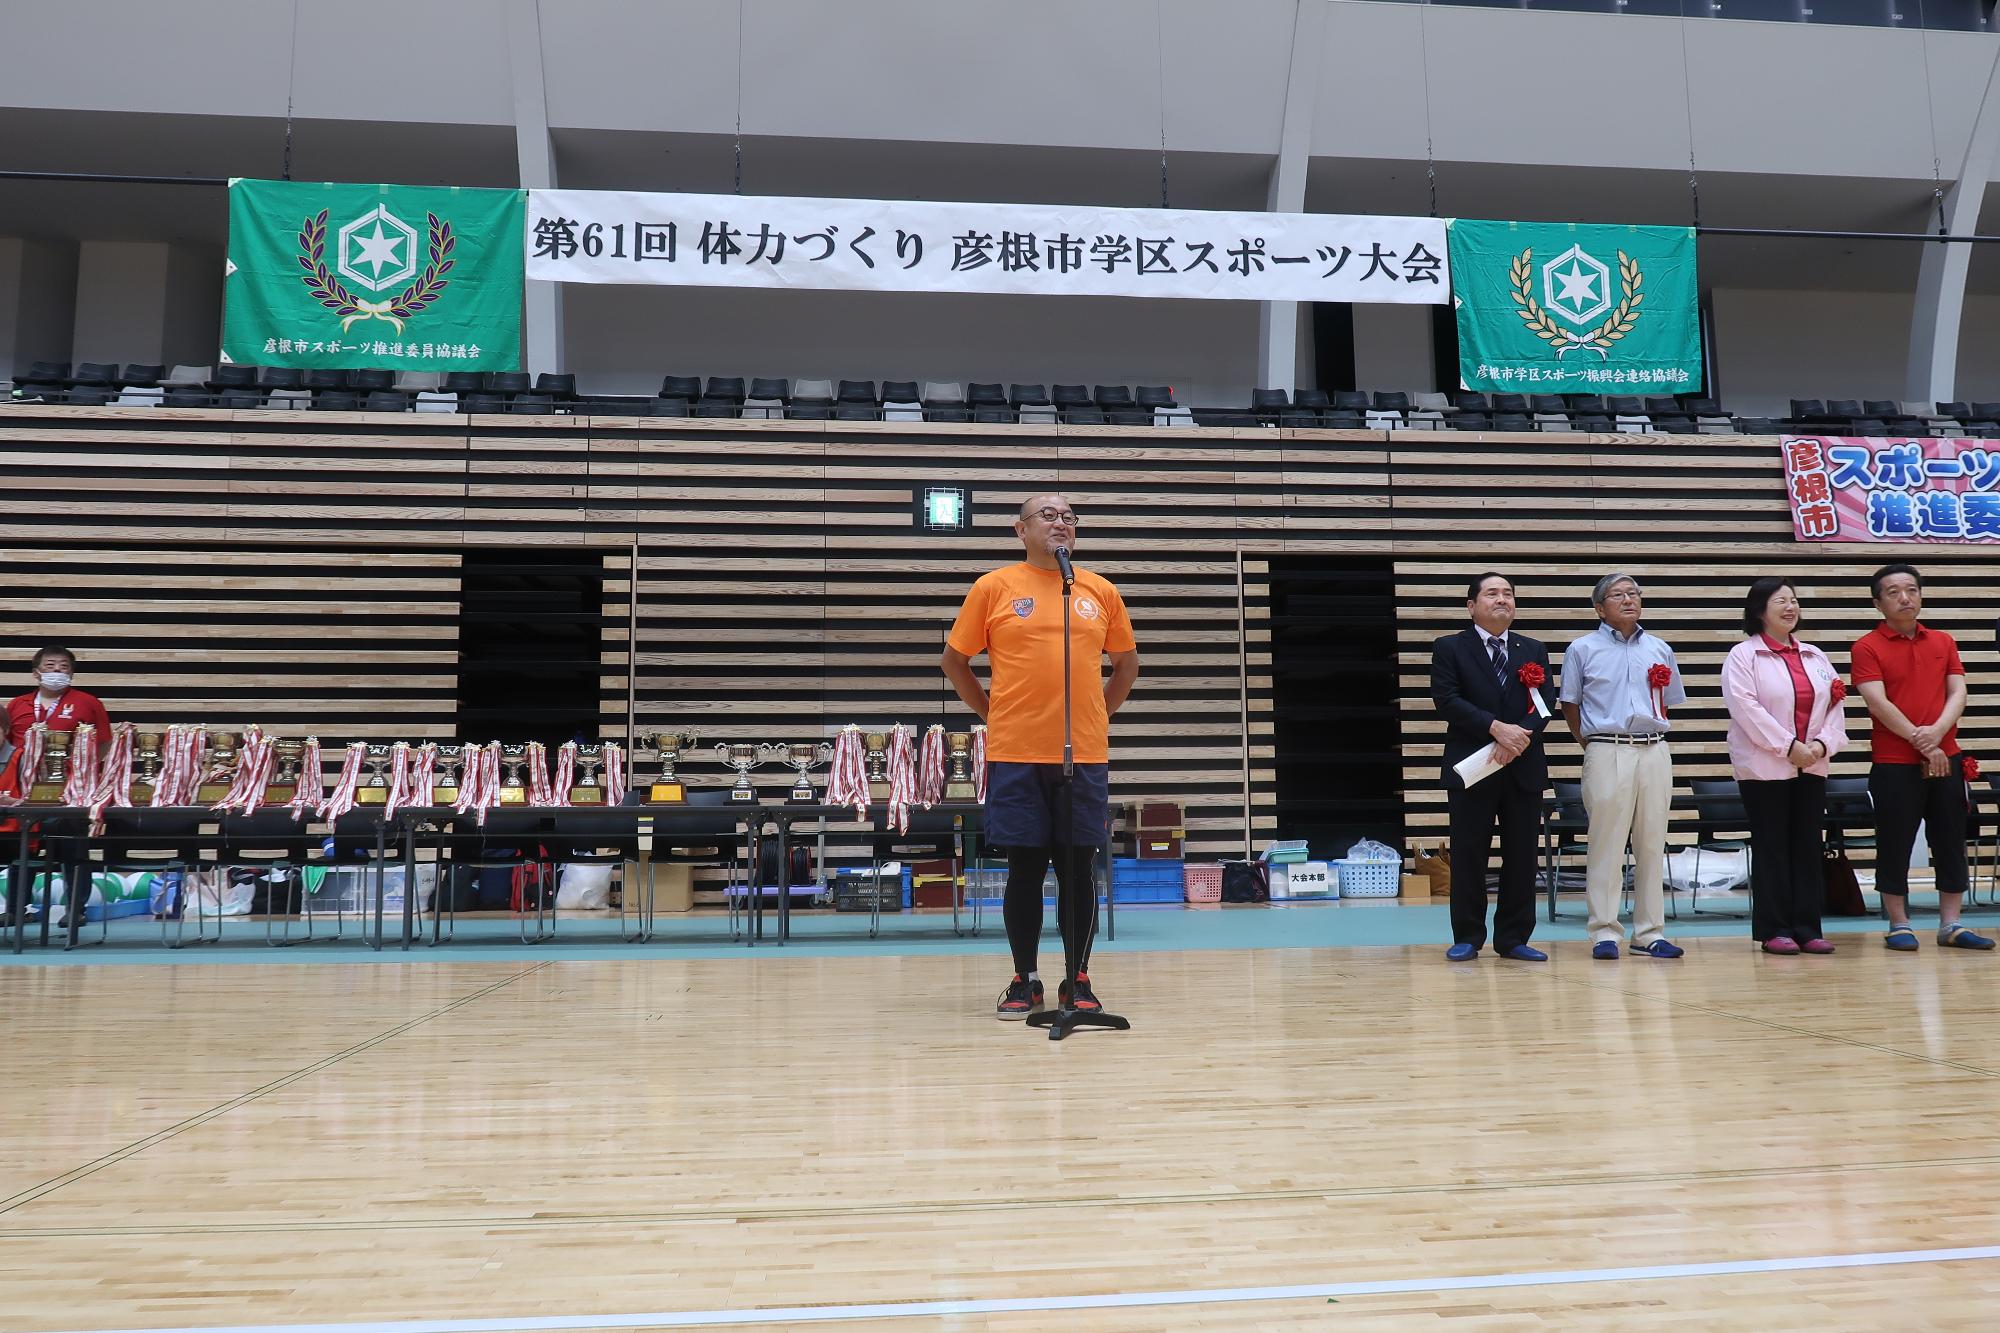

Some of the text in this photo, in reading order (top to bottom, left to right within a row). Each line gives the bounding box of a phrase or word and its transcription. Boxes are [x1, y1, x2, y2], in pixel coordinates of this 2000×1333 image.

[532, 216, 1442, 285] 第61回 体力づくり 彦根市学区スポーツ大会
[263, 338, 482, 359] 彦根市スポーツ推進委員協議会
[1475, 363, 1689, 383] 彦根市学区スポーツ振興会連絡協議会
[1787, 441, 1836, 536] 彦根市
[1829, 444, 2000, 490] スポーツ
[1870, 492, 2000, 536] 推進委
[1291, 873, 1325, 882] 大会本部
